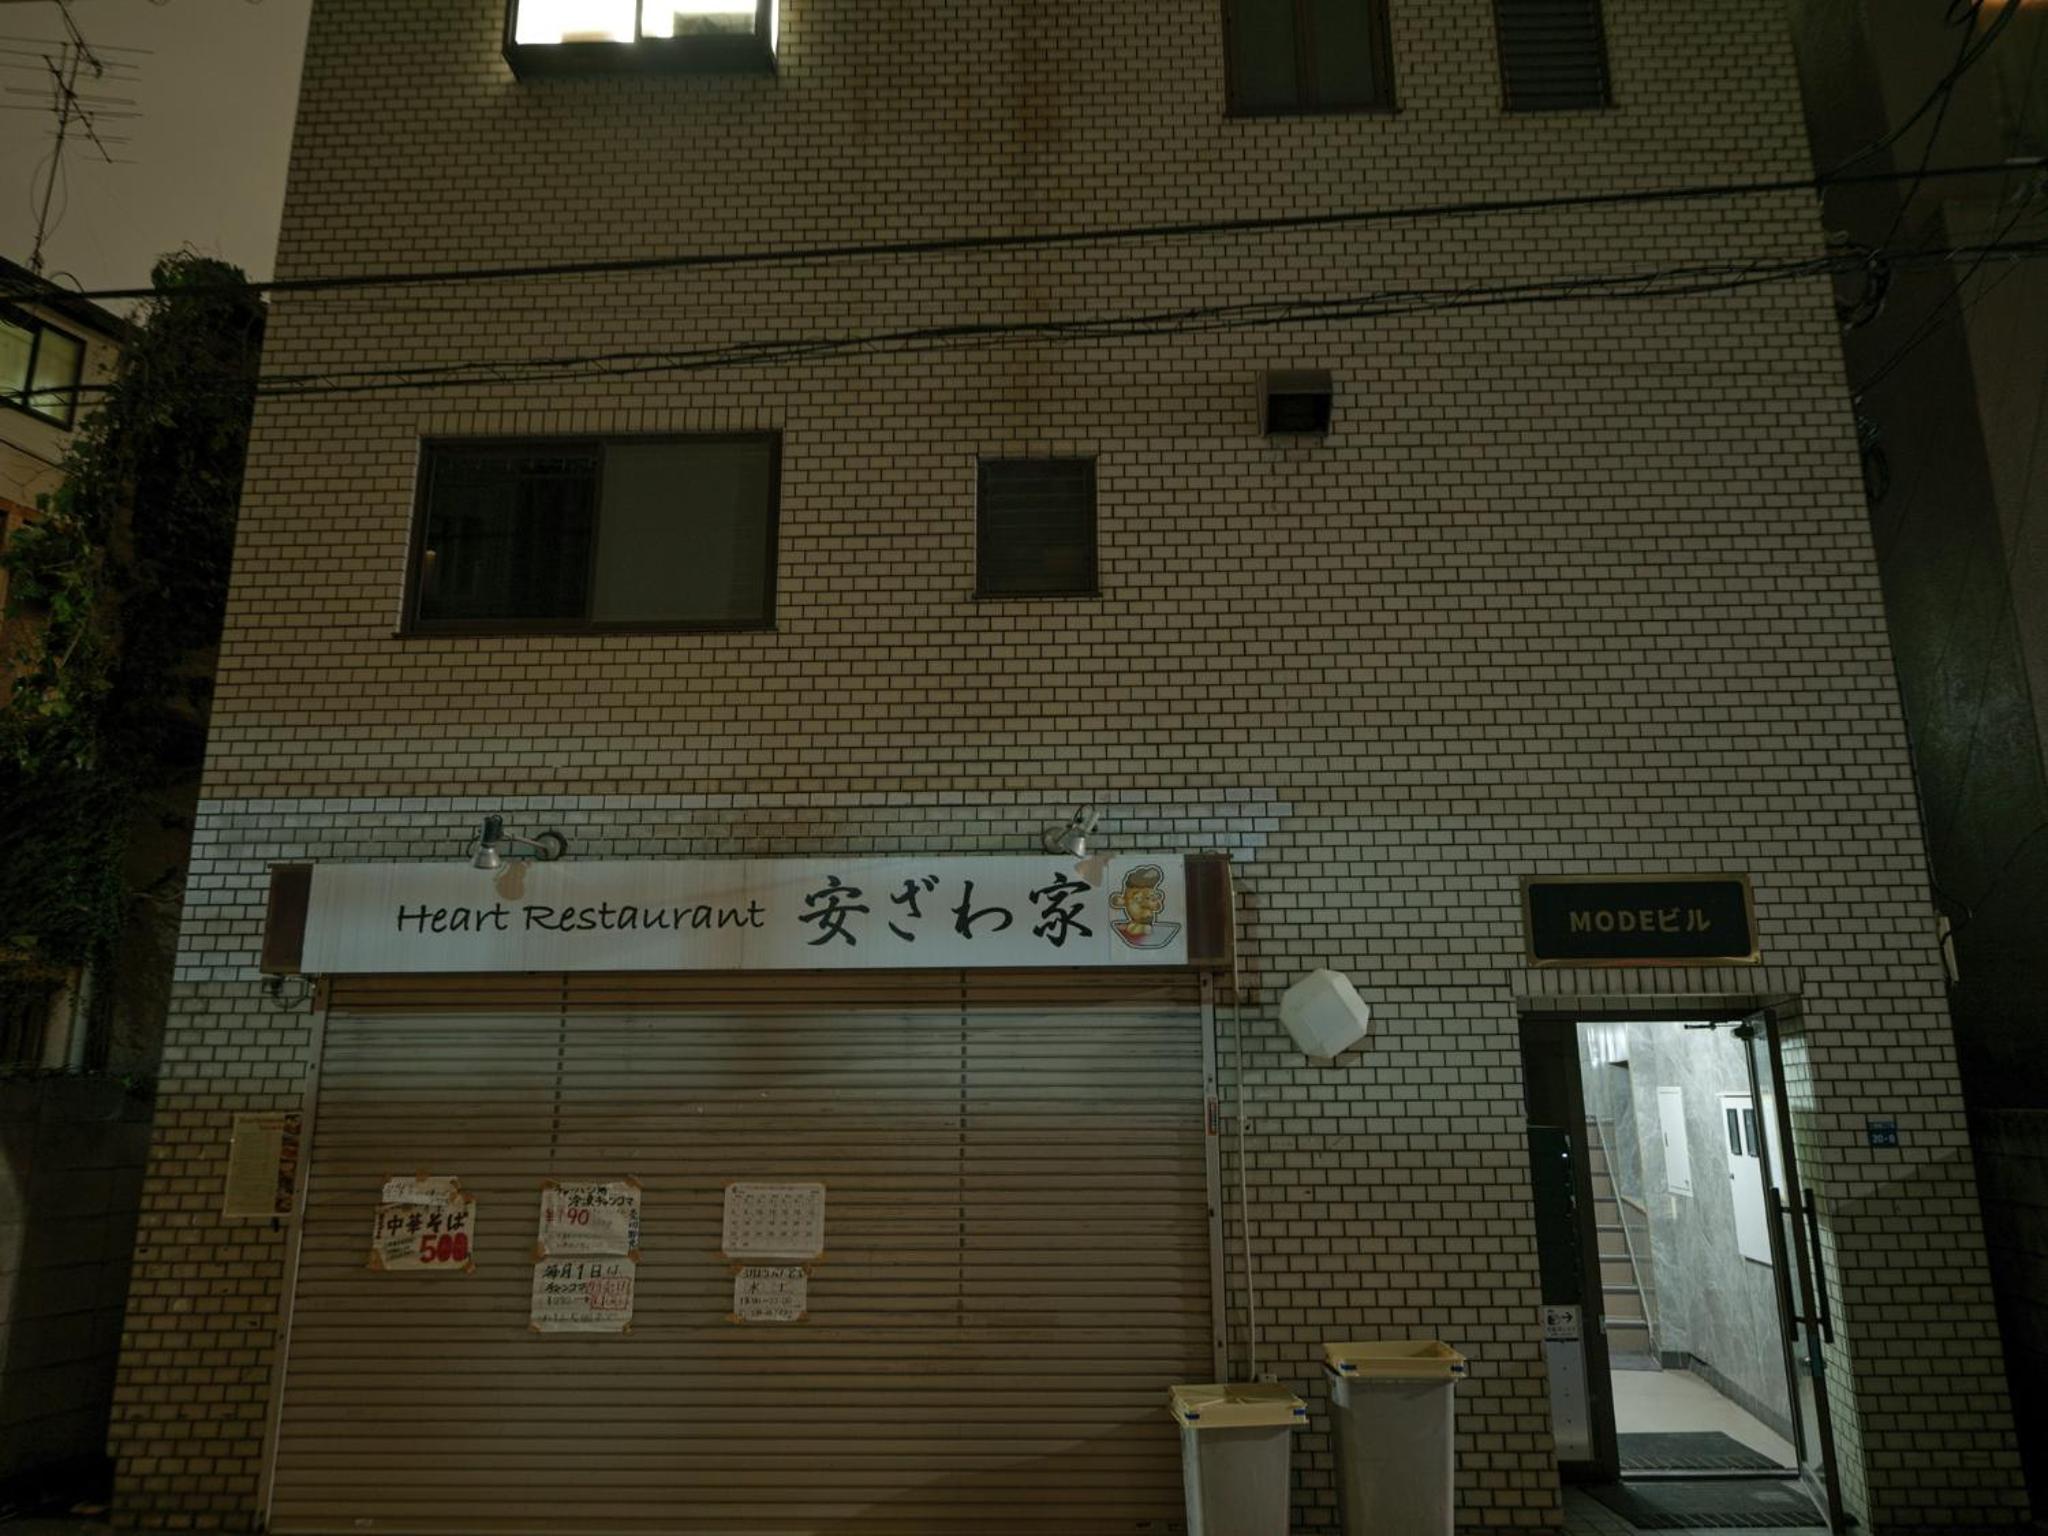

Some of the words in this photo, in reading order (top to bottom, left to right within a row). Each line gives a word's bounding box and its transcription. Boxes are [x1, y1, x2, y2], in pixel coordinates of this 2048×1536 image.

[398, 902, 510, 933] Heart
[523, 899, 767, 932] Restaurant
[797, 871, 1093, 949] 安ざわ家
[1569, 906, 1712, 933] MODEビル
[387, 1212, 469, 1236] 中華そば
[419, 1232, 468, 1263] 500
